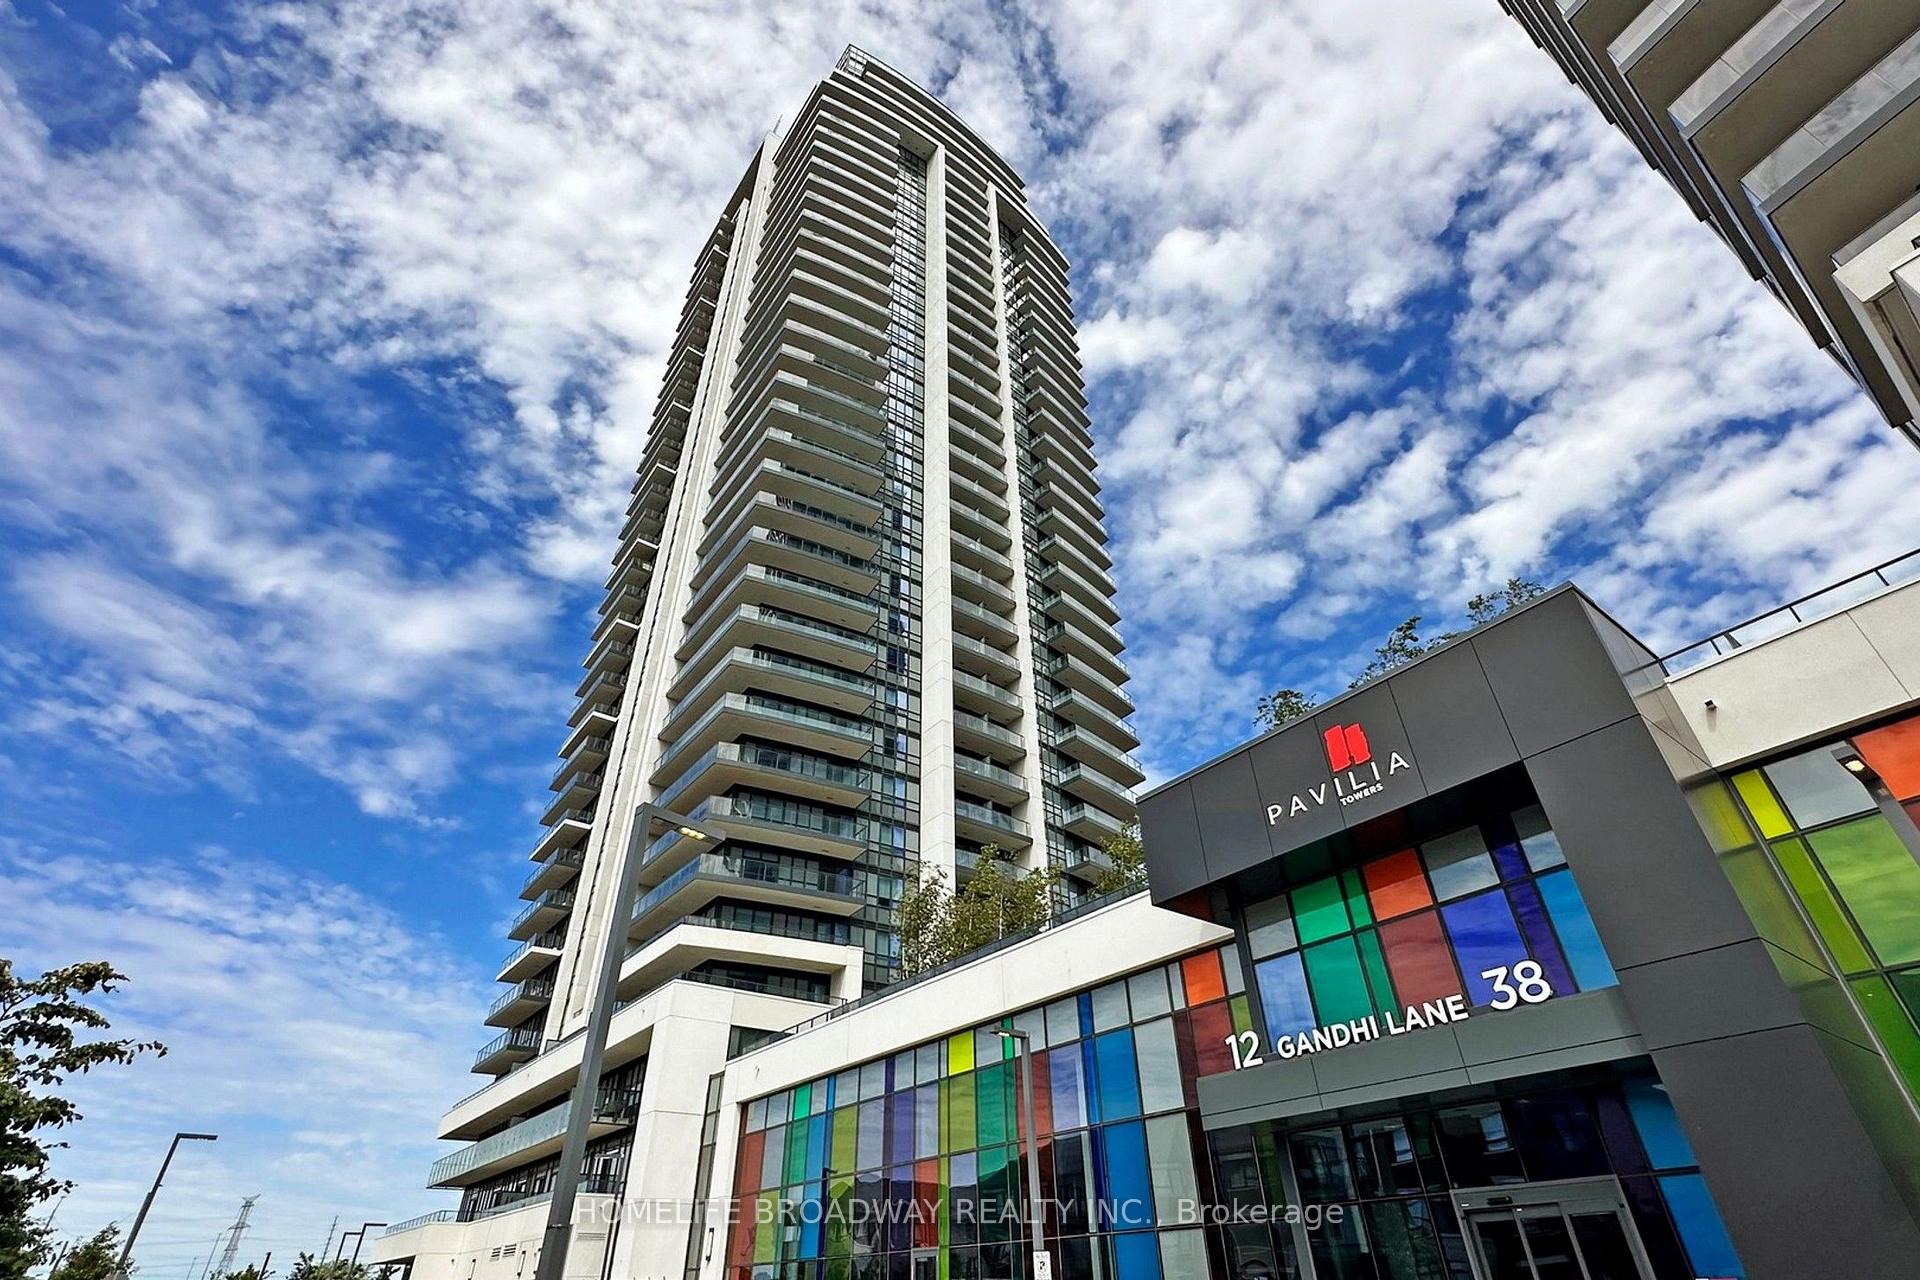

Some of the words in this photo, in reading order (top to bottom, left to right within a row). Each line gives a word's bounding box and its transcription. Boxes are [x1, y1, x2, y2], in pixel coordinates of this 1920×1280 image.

[1267, 752, 1410, 825] PAVILIA
[1340, 783, 1384, 806] TOWERS
[1224, 1031, 1264, 1070] 12
[1277, 1019, 1380, 1059] GANDHI
[1385, 994, 1469, 1036] LANE
[1481, 960, 1552, 1011] 38
